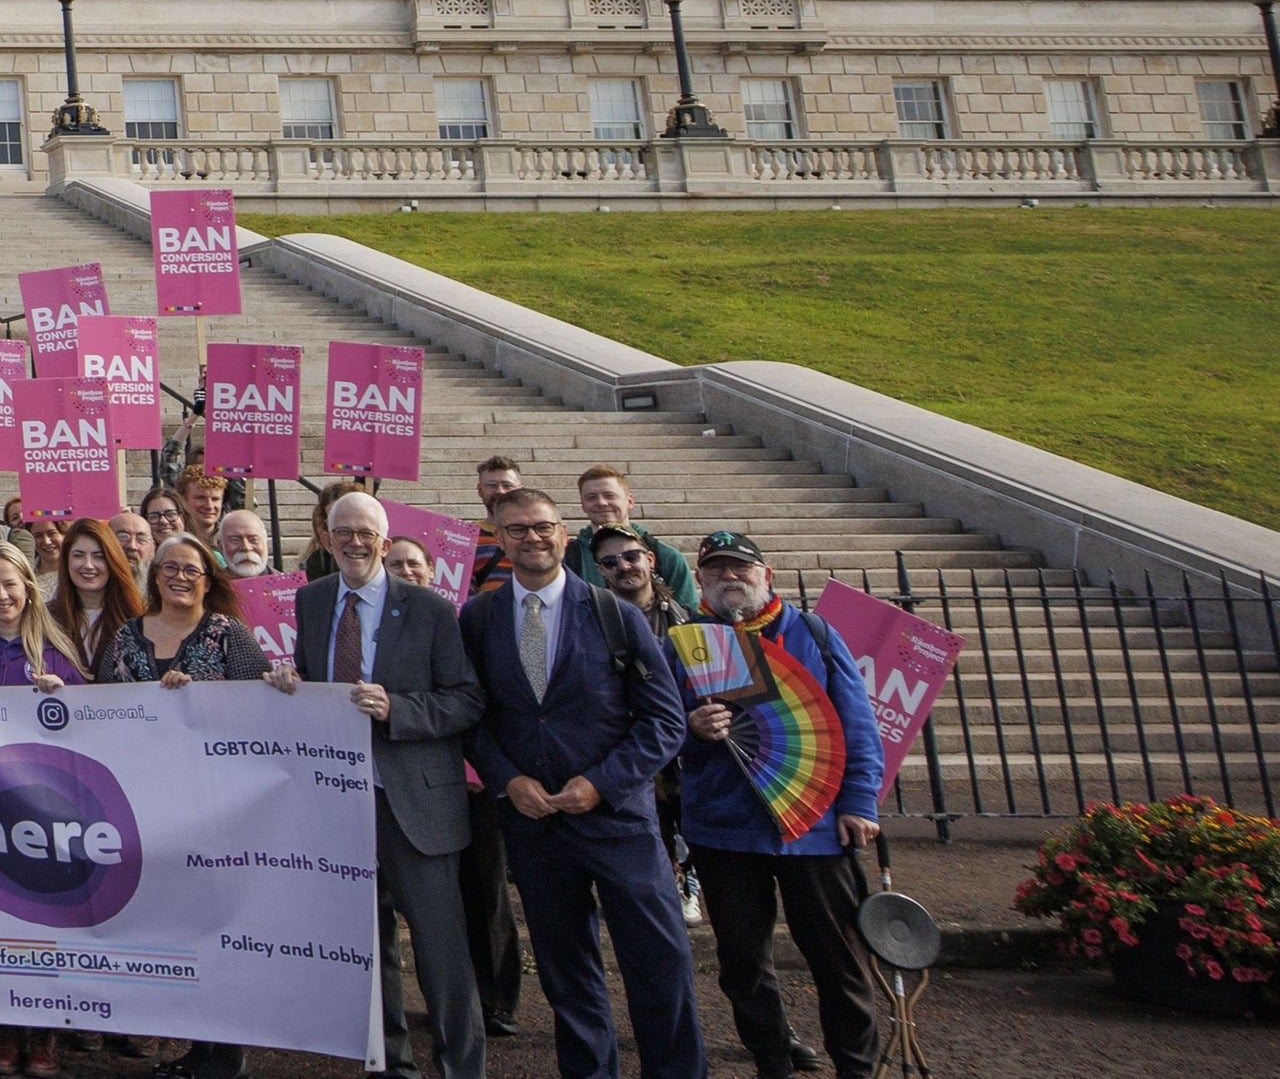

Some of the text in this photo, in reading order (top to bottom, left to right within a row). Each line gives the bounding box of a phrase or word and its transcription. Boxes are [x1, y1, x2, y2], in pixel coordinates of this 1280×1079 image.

[158, 226, 231, 252] BAN
[160, 252, 232, 263] CONVERSION
[161, 262, 233, 274] PRACTICES
[38, 340, 78, 353] PRACT
[84, 354, 153, 382] BAN
[107, 383, 153, 393] VERSION
[213, 382, 293, 412] BAN
[333, 380, 415, 413] BAN
[109, 394, 155, 405] CTICES
[212, 410, 293, 423] CONVERSION
[332, 408, 414, 424] CONVERSION
[22, 418, 107, 448] BAN
[212, 421, 293, 435] PRACTICES
[332, 418, 414, 437] PRACTICES
[24, 448, 108, 460] CONVERSION
[25, 460, 110, 473] PRACTICES
[254, 623, 298, 656] AN
[913, 645, 945, 663] Project
[855, 655, 929, 715] AN
[204, 741, 366, 766] LGBTQIA+ Heritage
[314, 771, 368, 792] Project
[186, 851, 375, 882] Mental Health Suppor
[0, 948, 26, 966] for
[31, 951, 121, 971] LGBTQIA+
[126, 960, 196, 977] women
[221, 934, 373, 971] Policy and Lobbyi
[10, 989, 112, 1018] hereni.org
